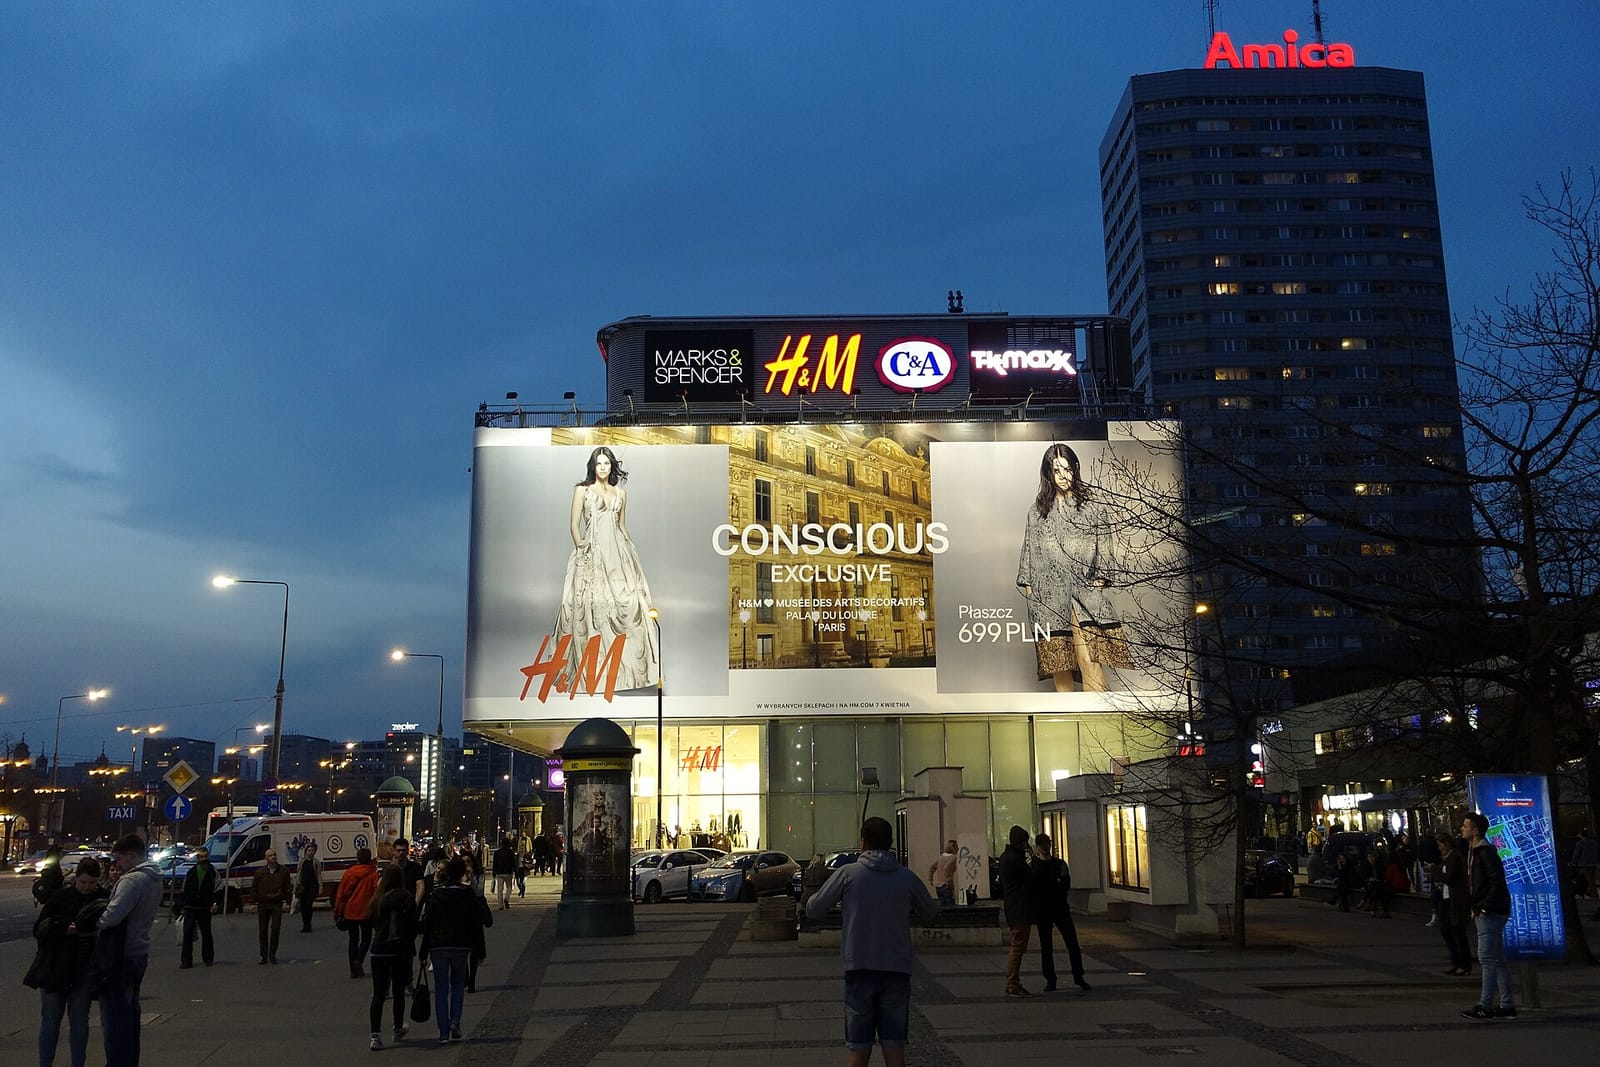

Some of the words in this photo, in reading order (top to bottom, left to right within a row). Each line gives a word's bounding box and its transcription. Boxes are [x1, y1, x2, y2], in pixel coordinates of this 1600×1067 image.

[1204, 29, 1355, 69] Amica
[655, 349, 742, 366] MARKS&
[764, 334, 862, 395] H&M
[890, 351, 943, 376] C&A
[655, 367, 743, 384] SPENCER
[712, 522, 949, 556] CONSCIOUS
[771, 564, 891, 583] EXCLUSIVE
[738, 599, 762, 608] H&M
[776, 597, 810, 607] MUSÉE
[812, 598, 832, 607] DES
[834, 598, 861, 607] ARTS
[958, 605, 1013, 619] Płaszcz
[822, 611, 836, 620] DU
[818, 623, 847, 632] PARIS
[958, 622, 1002, 643] 699
[1006, 622, 1051, 643] PLN
[520, 633, 627, 704] H&M
[681, 745, 721, 773] H&M
[109, 807, 133, 819] TAXI
